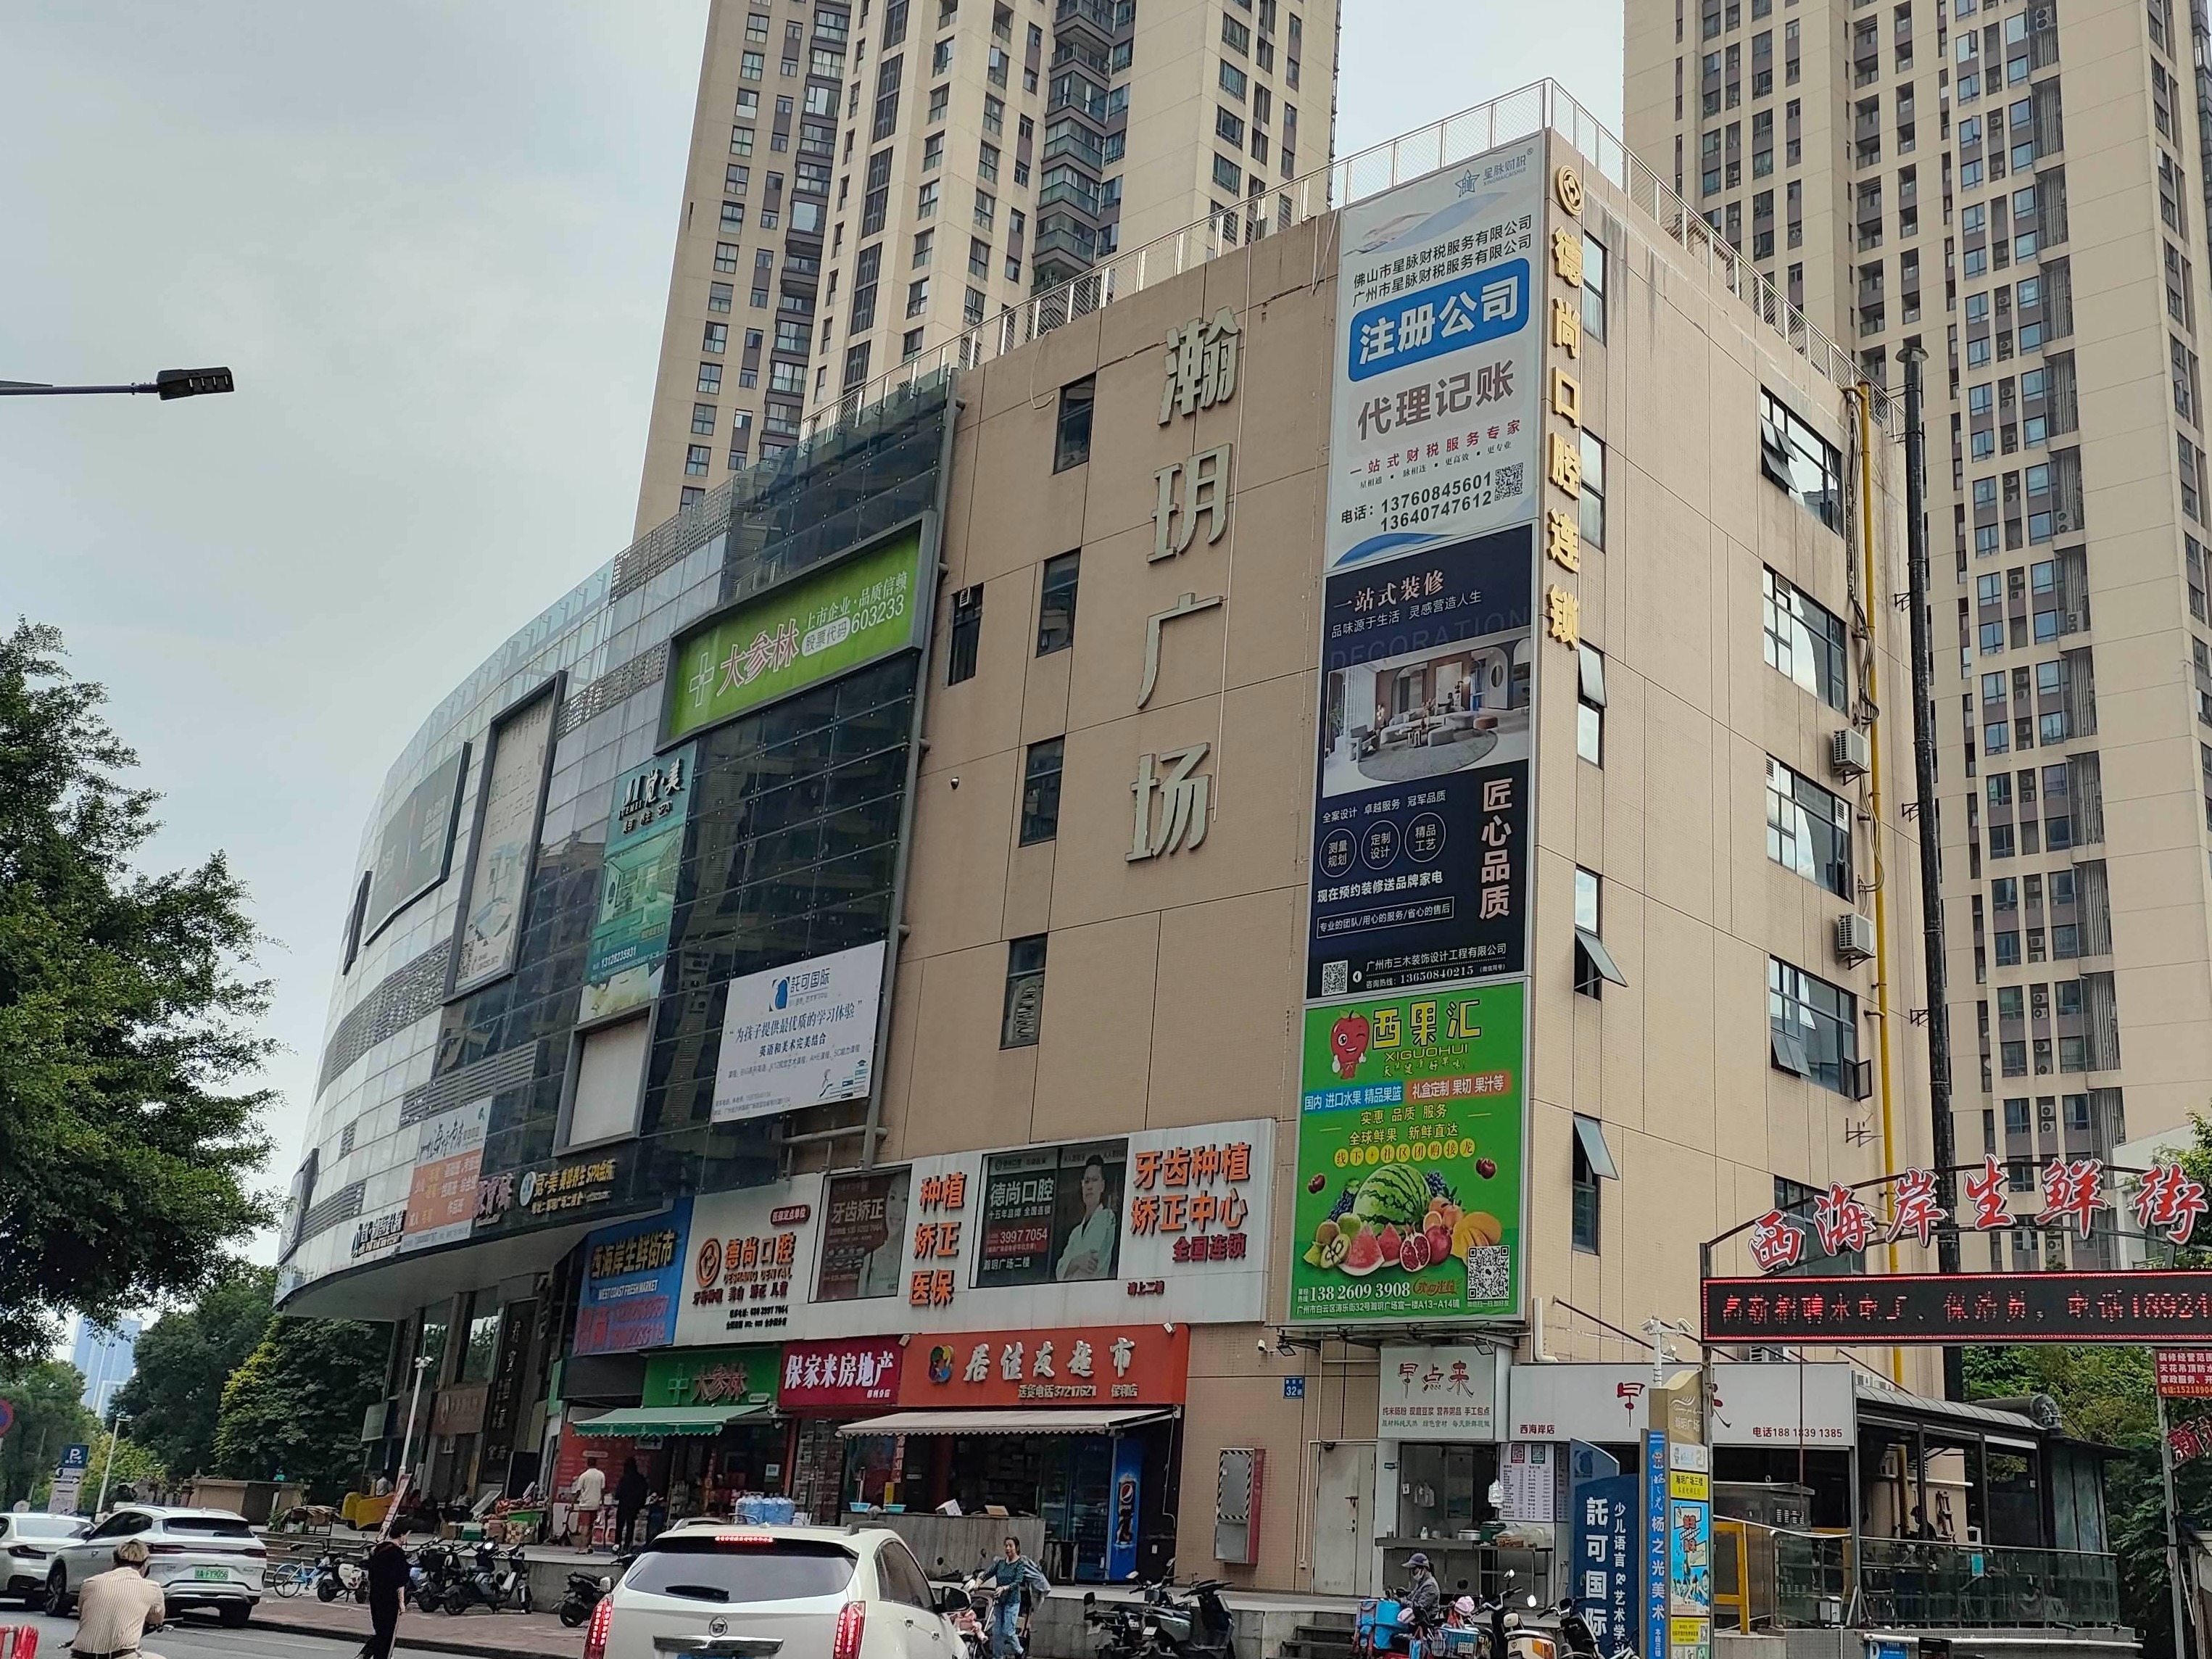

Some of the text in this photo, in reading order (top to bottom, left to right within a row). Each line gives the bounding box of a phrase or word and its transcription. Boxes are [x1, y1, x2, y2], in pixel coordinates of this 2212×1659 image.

[1483, 154, 1527, 180] 星脉财税
[1353, 233, 1531, 307] 广州市星脉财税服务有限公司
[1354, 215, 1531, 288] 佛山市星脉财税服务有限公司
[1359, 275, 1519, 365] 注册公司
[1358, 360, 1514, 441] 代理记账
[1350, 419, 1521, 474] 一站式财税服务专家
[1547, 226, 1584, 650] 德尚口腔连锁
[1380, 490, 1492, 533] 13640747612
[1381, 471, 1491, 514] 13760845601
[1125, 306, 1241, 863] 瀚玥广场
[1333, 569, 1444, 613] 一站式装修
[851, 595, 905, 634] 603233
[1331, 590, 1482, 638] 品味源于生活 灵感营造人生
[805, 622, 848, 654] 股票代码
[716, 618, 799, 698] 大参林
[1322, 790, 1446, 824] 全案设计 卓越服务 冠军品质
[1327, 840, 1348, 855] 测量
[1370, 832, 1391, 847] 定制
[1414, 824, 1436, 839] 精品
[1414, 838, 1436, 853] 工艺
[1479, 777, 1513, 920] 匠心品质
[1327, 854, 1347, 869] 规划
[1370, 846, 1391, 861] 设计
[1317, 870, 1443, 904] 现在预约装修送品牌家电
[1365, 943, 1507, 972] 广州市三木装饰设计工程有限公司
[1400, 964, 1475, 984] 13650840215
[1372, 999, 1483, 1050] 西果汇
[759, 1032, 827, 1059] 英语和美术完美结合
[1385, 1043, 1468, 1063] XIGUOHUI
[1304, 1074, 1505, 1112] 国内 进口水果 精品果篮 礼盒定制 果切 果汁等
[1361, 1103, 1449, 1125] 实惠 品质 服务
[1349, 1123, 1459, 1146] 全球鲜果 新鲜直达
[1132, 1141, 1252, 1189] 牙齿种植
[919, 1172, 967, 1211] 种植
[990, 1177, 1055, 1208] 德尚口腔
[831, 1198, 885, 1224] 牙齿矫正
[1130, 1188, 1248, 1235] 矫正中心
[1748, 1153, 2209, 1271] 西海岸生鲜街
[725, 1232, 797, 1270] 德尚口腔
[914, 1222, 963, 1260] 矫正
[1000, 1229, 1024, 1244] 3997
[1024, 1227, 1048, 1243] 7054
[1172, 1233, 1248, 1262] 全国连锁
[909, 1270, 956, 1307] 医保
[1309, 1285, 1335, 1302] 138
[1338, 1283, 1372, 1300] 2609
[1375, 1281, 1410, 1299] 3908
[690, 1362, 748, 1404] 大参林
[784, 1349, 894, 1391] 保家来房地产
[1398, 1360, 1475, 1399] 早点来
[1520, 1424, 1555, 1436] 西海岸店
[1793, 1427, 1816, 1439] 1839
[1819, 1428, 1843, 1439] 1385
[1586, 1496, 1609, 1637] 託可国际
[1651, 1515, 1666, 1621] 杨之光美术
